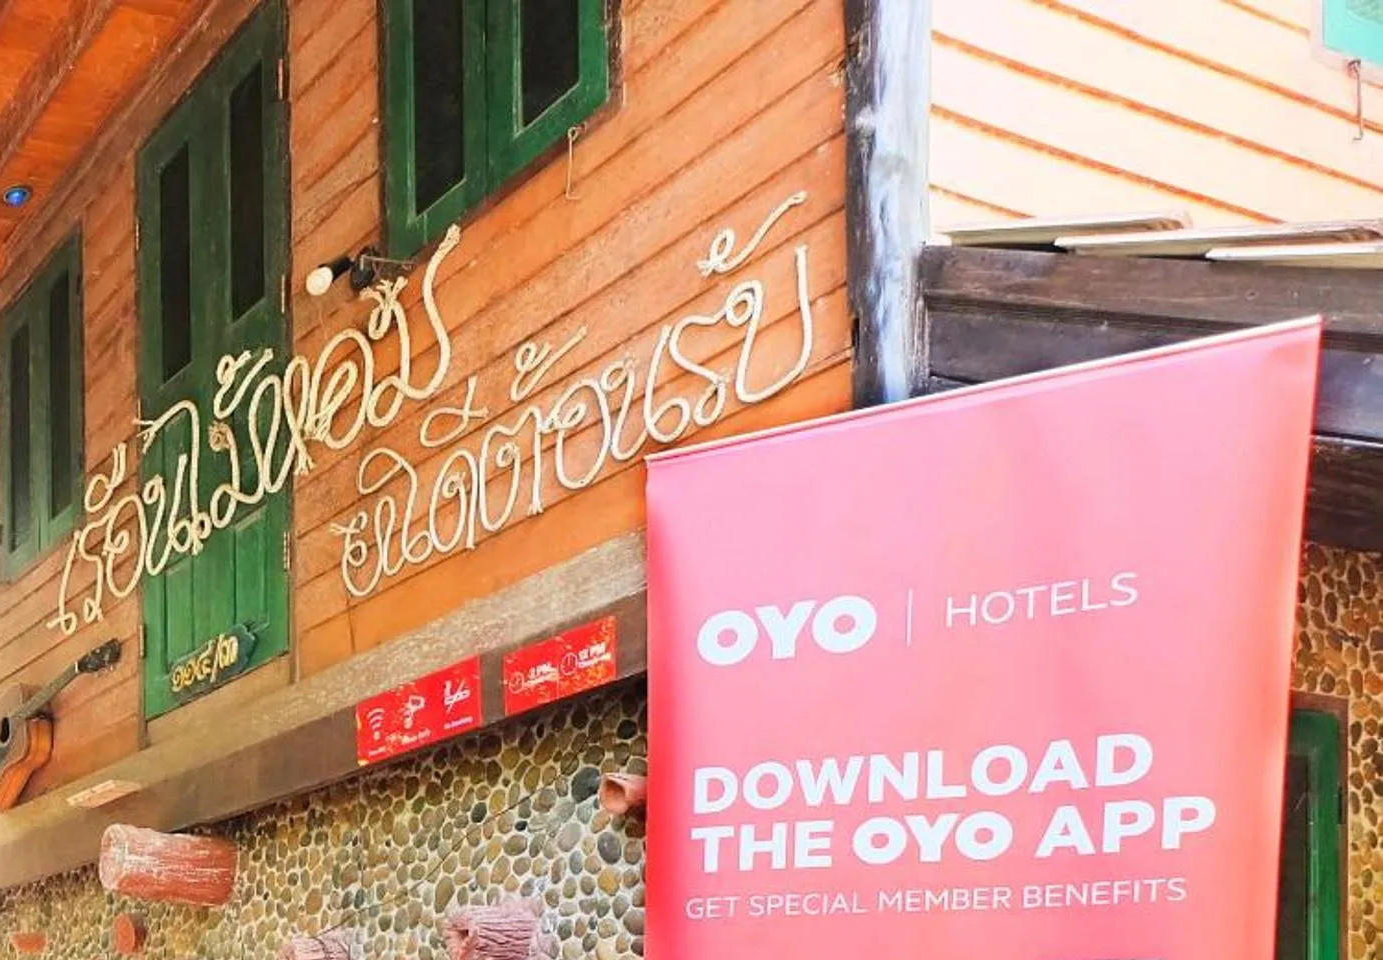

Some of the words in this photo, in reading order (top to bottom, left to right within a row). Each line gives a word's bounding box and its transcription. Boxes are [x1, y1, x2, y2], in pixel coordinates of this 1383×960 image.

[329, 191, 813, 598] ยินดีต้อนรับ
[696, 594, 878, 667] OYO
[945, 571, 1139, 629] HOTELS
[693, 732, 1154, 815] DOWNLOAD
[690, 819, 834, 874] THE
[852, 810, 1014, 865] OYO
[1033, 795, 1217, 859] APP
[685, 895, 742, 920] GET
[747, 890, 868, 917] SPECIAL
[877, 885, 1013, 913] MEMBER
[1022, 876, 1188, 909] BENEFITS
